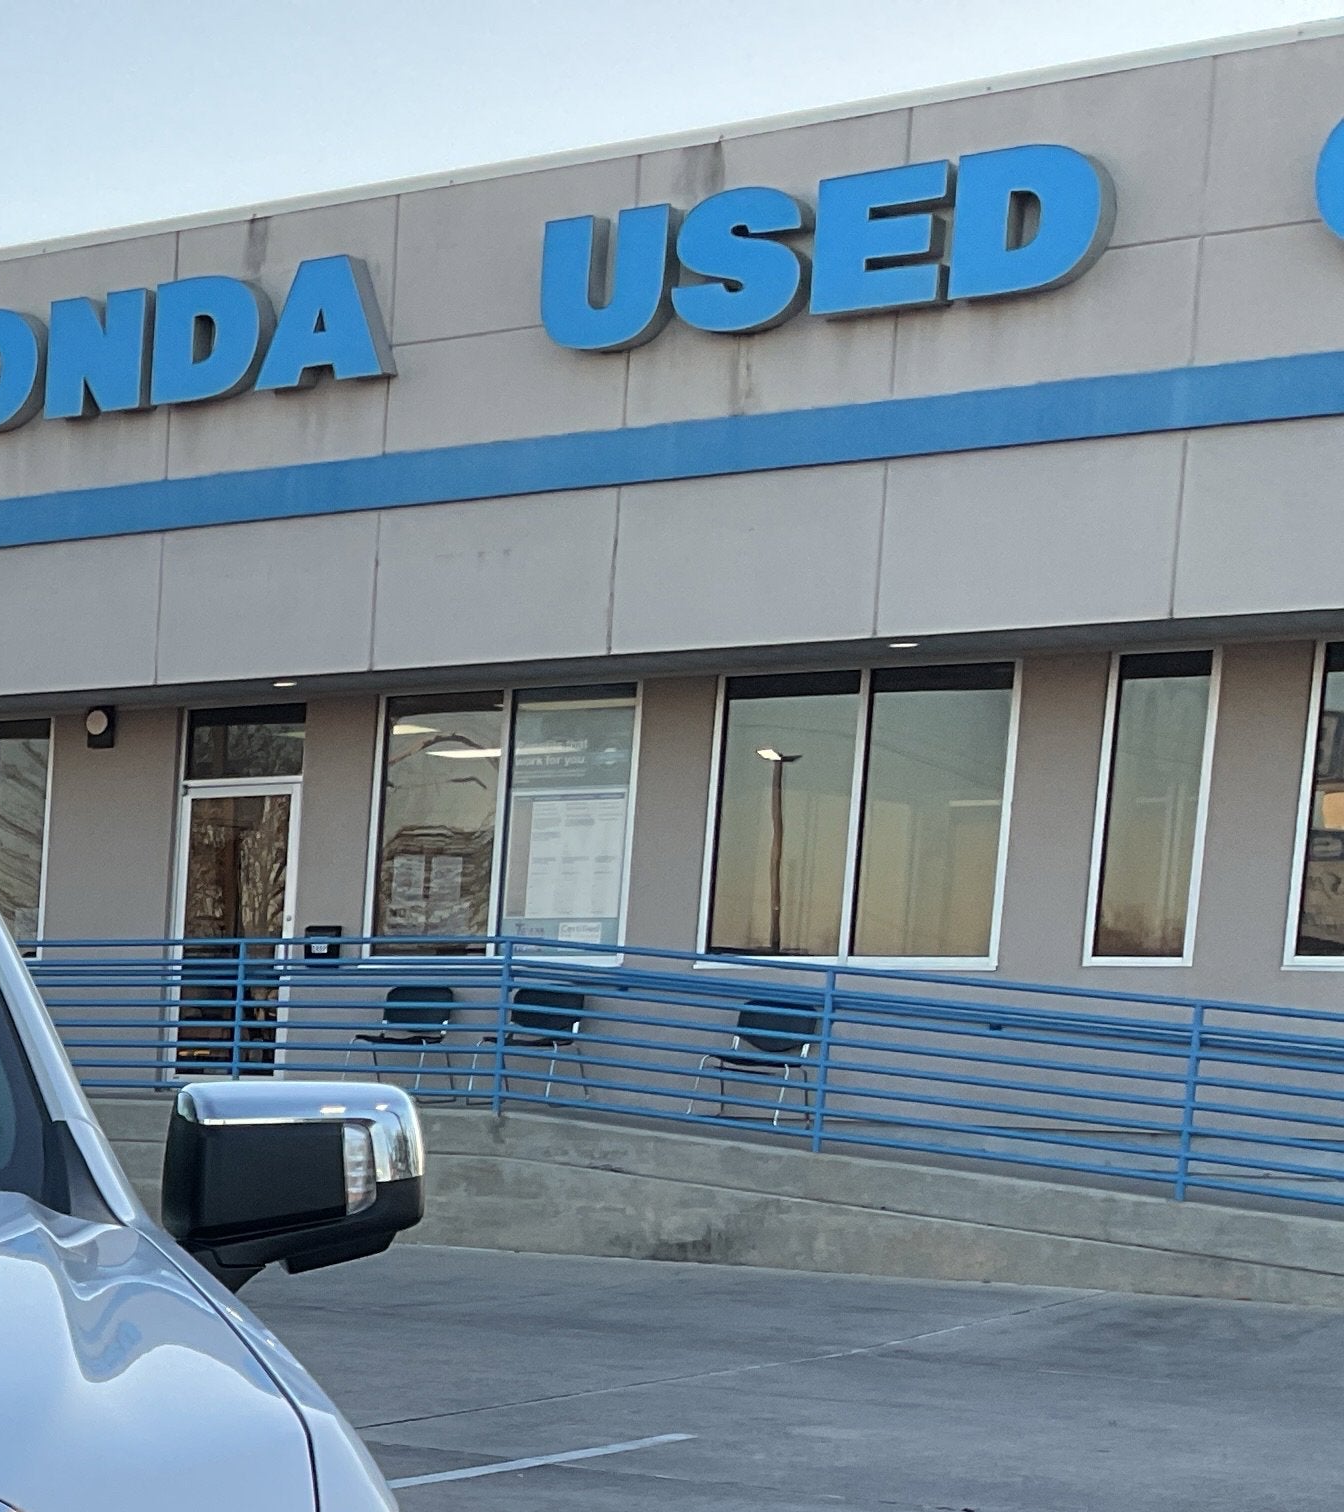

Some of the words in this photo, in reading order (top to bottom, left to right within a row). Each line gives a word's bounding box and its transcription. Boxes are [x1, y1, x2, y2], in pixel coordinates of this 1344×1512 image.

[540, 143, 1116, 352] USED
[545, 754, 561, 766] for
[563, 754, 586, 767] you
